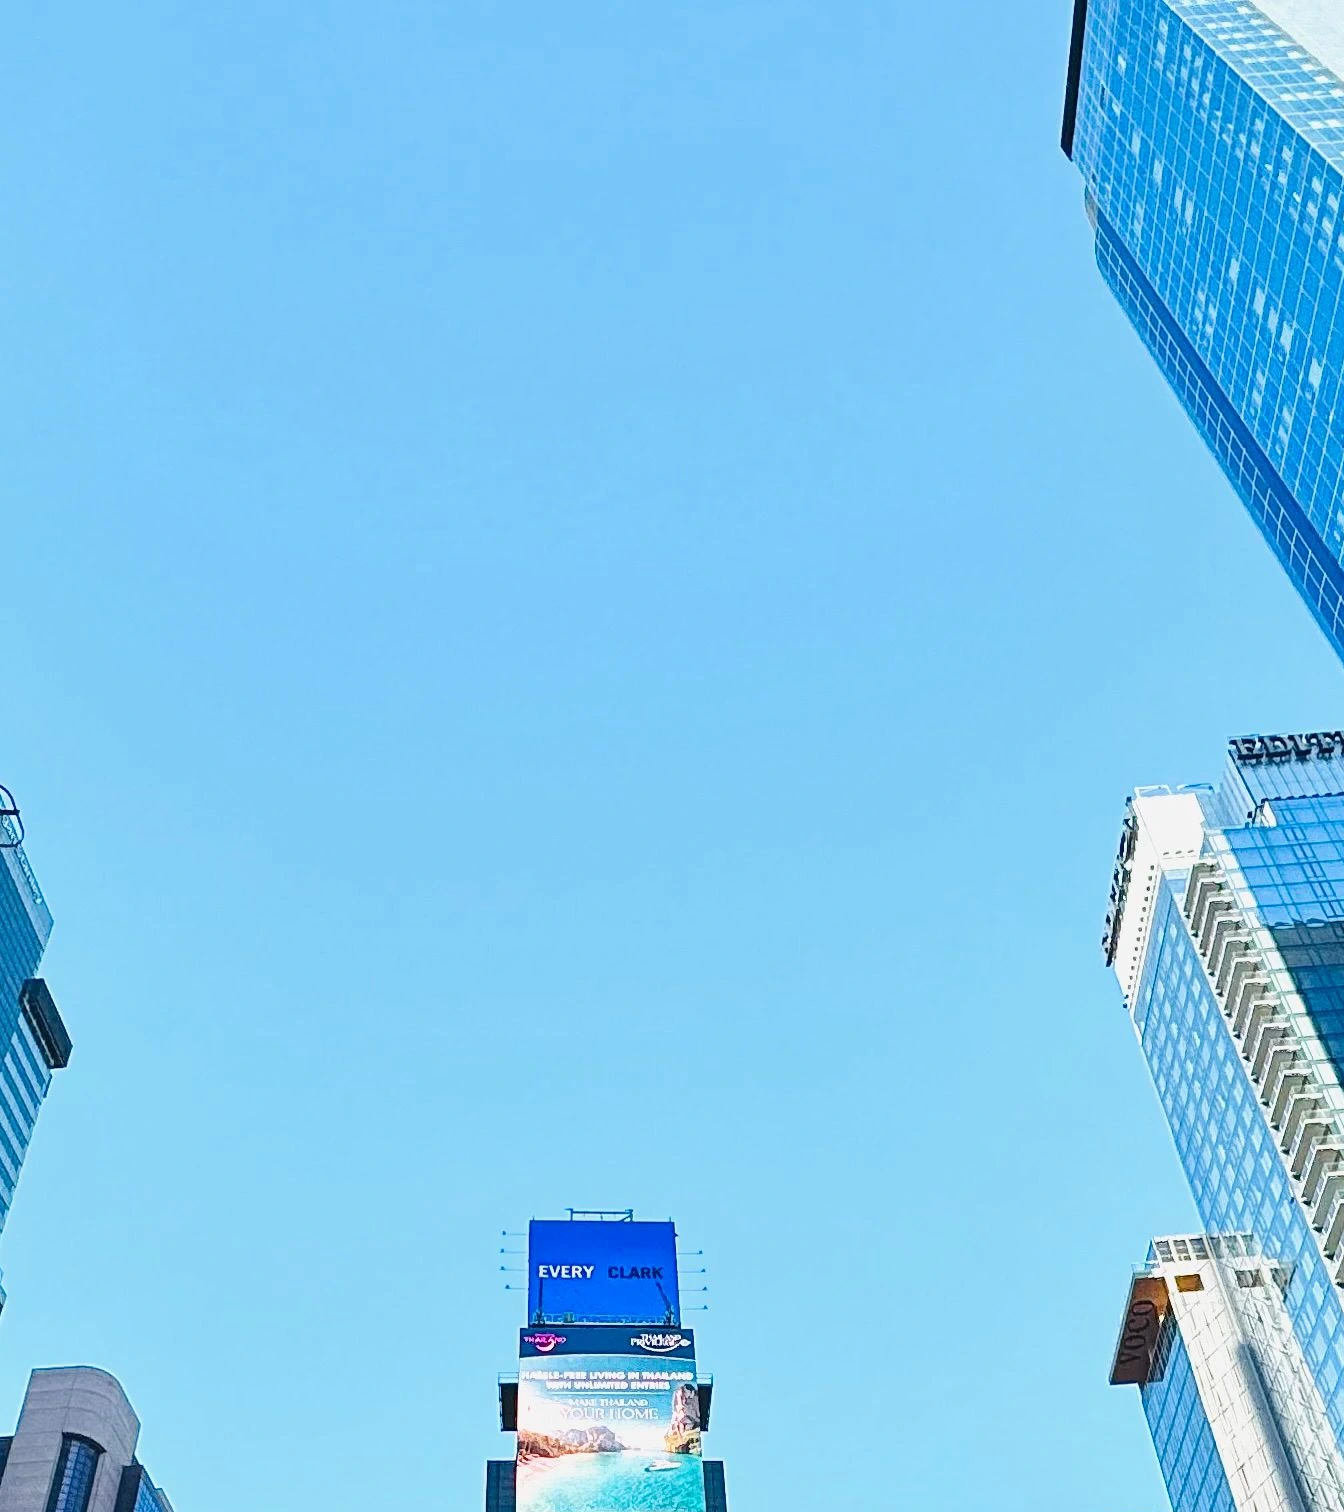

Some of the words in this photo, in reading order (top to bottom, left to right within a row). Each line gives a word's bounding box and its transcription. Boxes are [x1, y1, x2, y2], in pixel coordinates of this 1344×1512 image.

[538, 1265, 595, 1279] EVERY
[607, 1265, 664, 1280] CLARK
[589, 1371, 626, 1381] LIVING
[627, 1371, 641, 1381] IN
[641, 1371, 694, 1381] THAILAND
[573, 1381, 629, 1390] UNLIMITED
[630, 1381, 671, 1390] ENTRIES
[560, 1407, 605, 1420] YOUR
[609, 1407, 659, 1420] HOME
